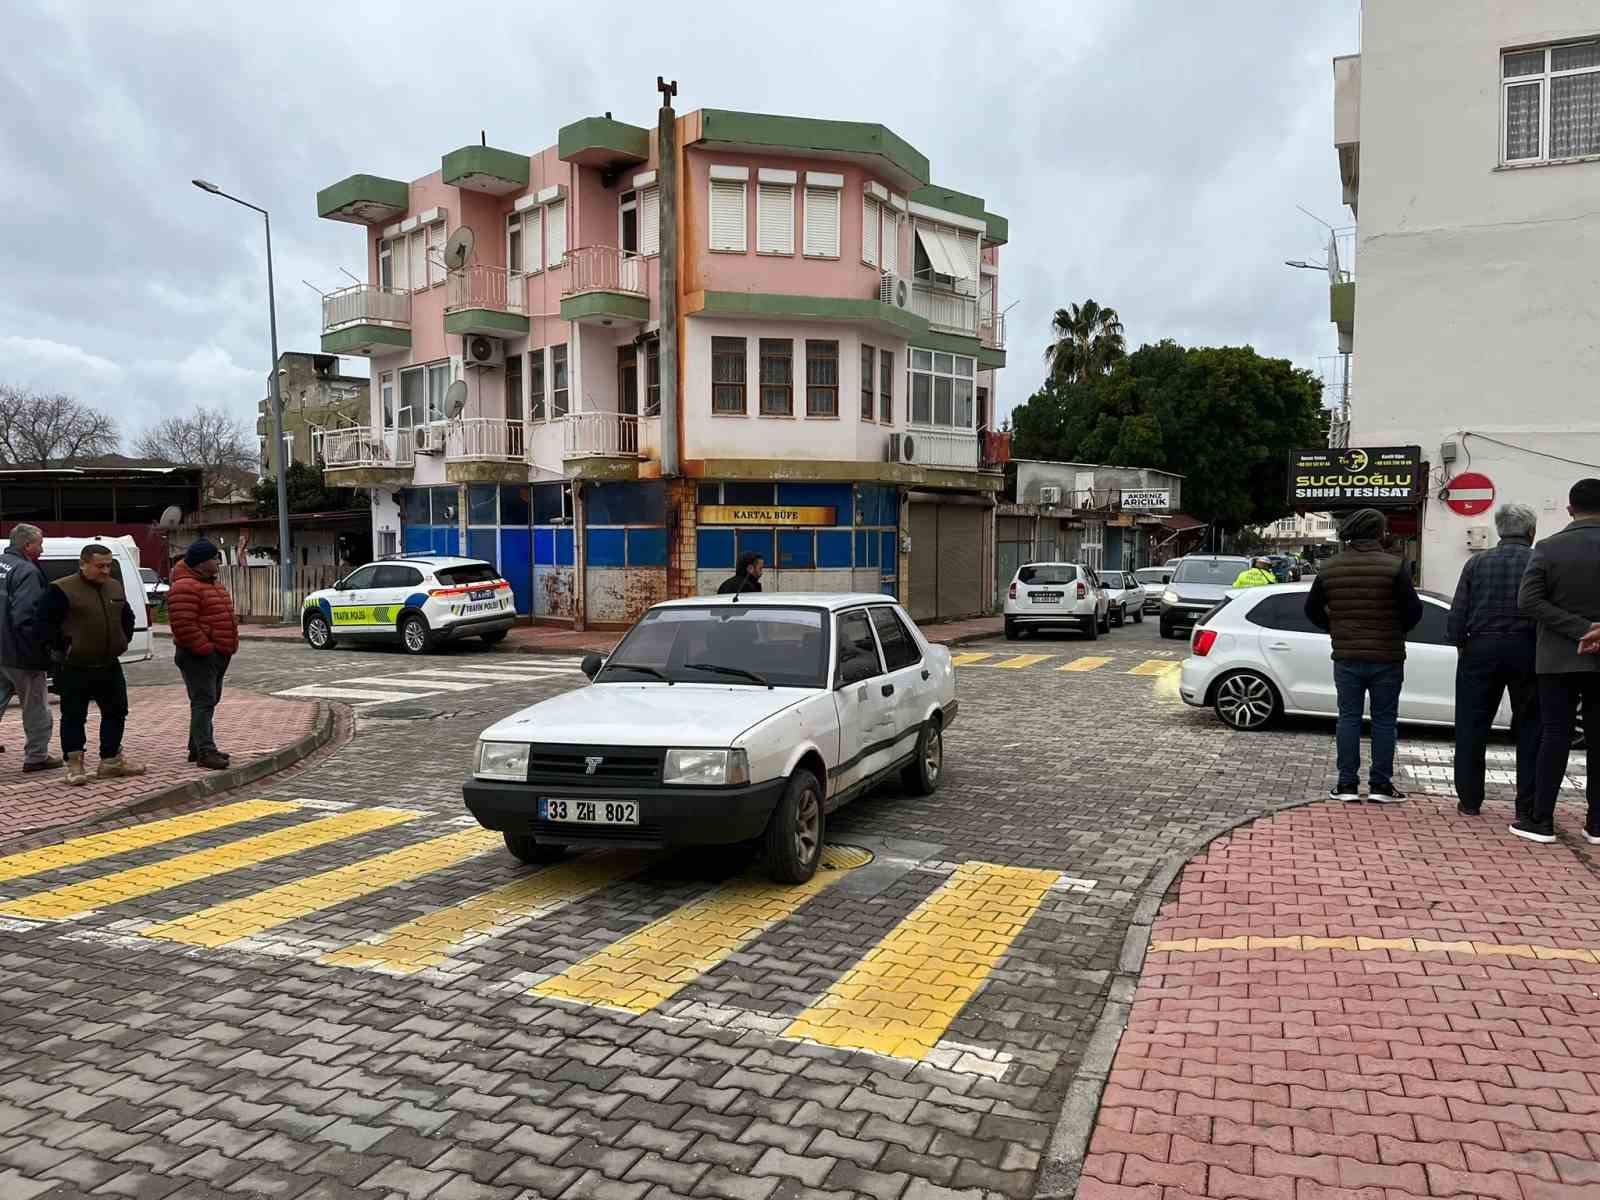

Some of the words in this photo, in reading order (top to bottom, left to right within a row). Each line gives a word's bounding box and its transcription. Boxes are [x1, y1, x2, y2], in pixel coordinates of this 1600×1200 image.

[1296, 472, 1412, 487] SUCUOĞLU
[1296, 486, 1340, 498] SIHHİ
[1344, 486, 1411, 497] TESİSAT
[734, 511, 772, 520] KARTAL
[774, 510, 799, 520] BÜFE
[549, 801, 568, 819] 33
[576, 802, 596, 821] ZH
[605, 803, 635, 822] 802
